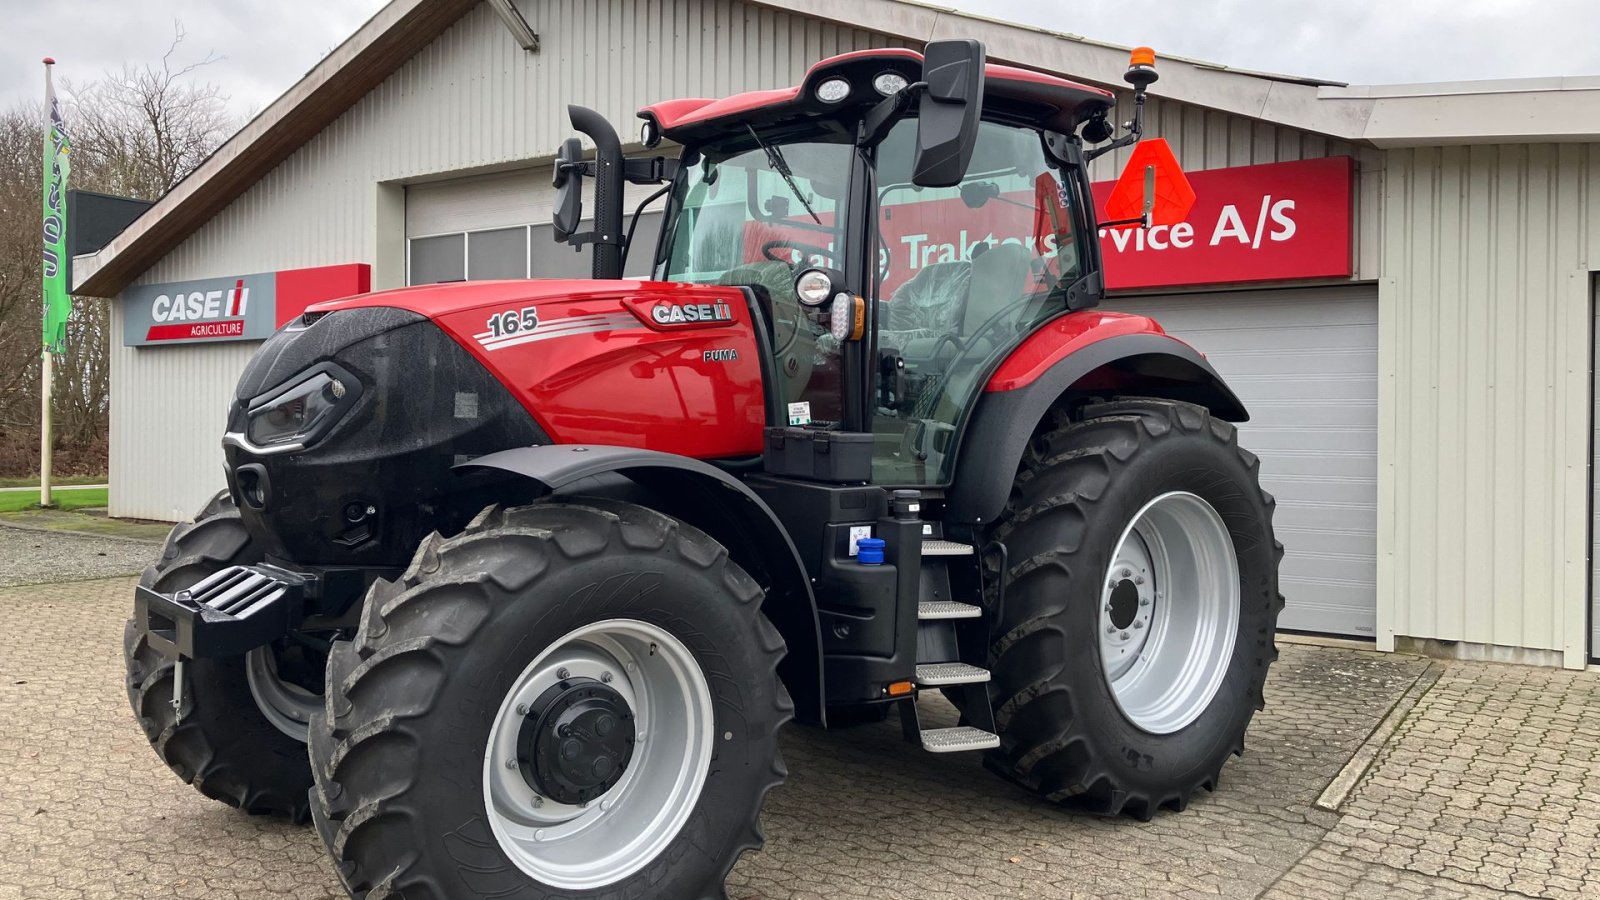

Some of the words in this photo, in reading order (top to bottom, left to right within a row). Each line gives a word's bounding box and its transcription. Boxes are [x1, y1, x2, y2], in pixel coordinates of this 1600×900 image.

[1209, 194, 1297, 249] A/S
[151, 290, 222, 323] CASE
[651, 303, 712, 323] CASE
[190, 322, 242, 337] AGRICULTURE
[487, 306, 539, 339] 165
[703, 349, 738, 363] PUMA
